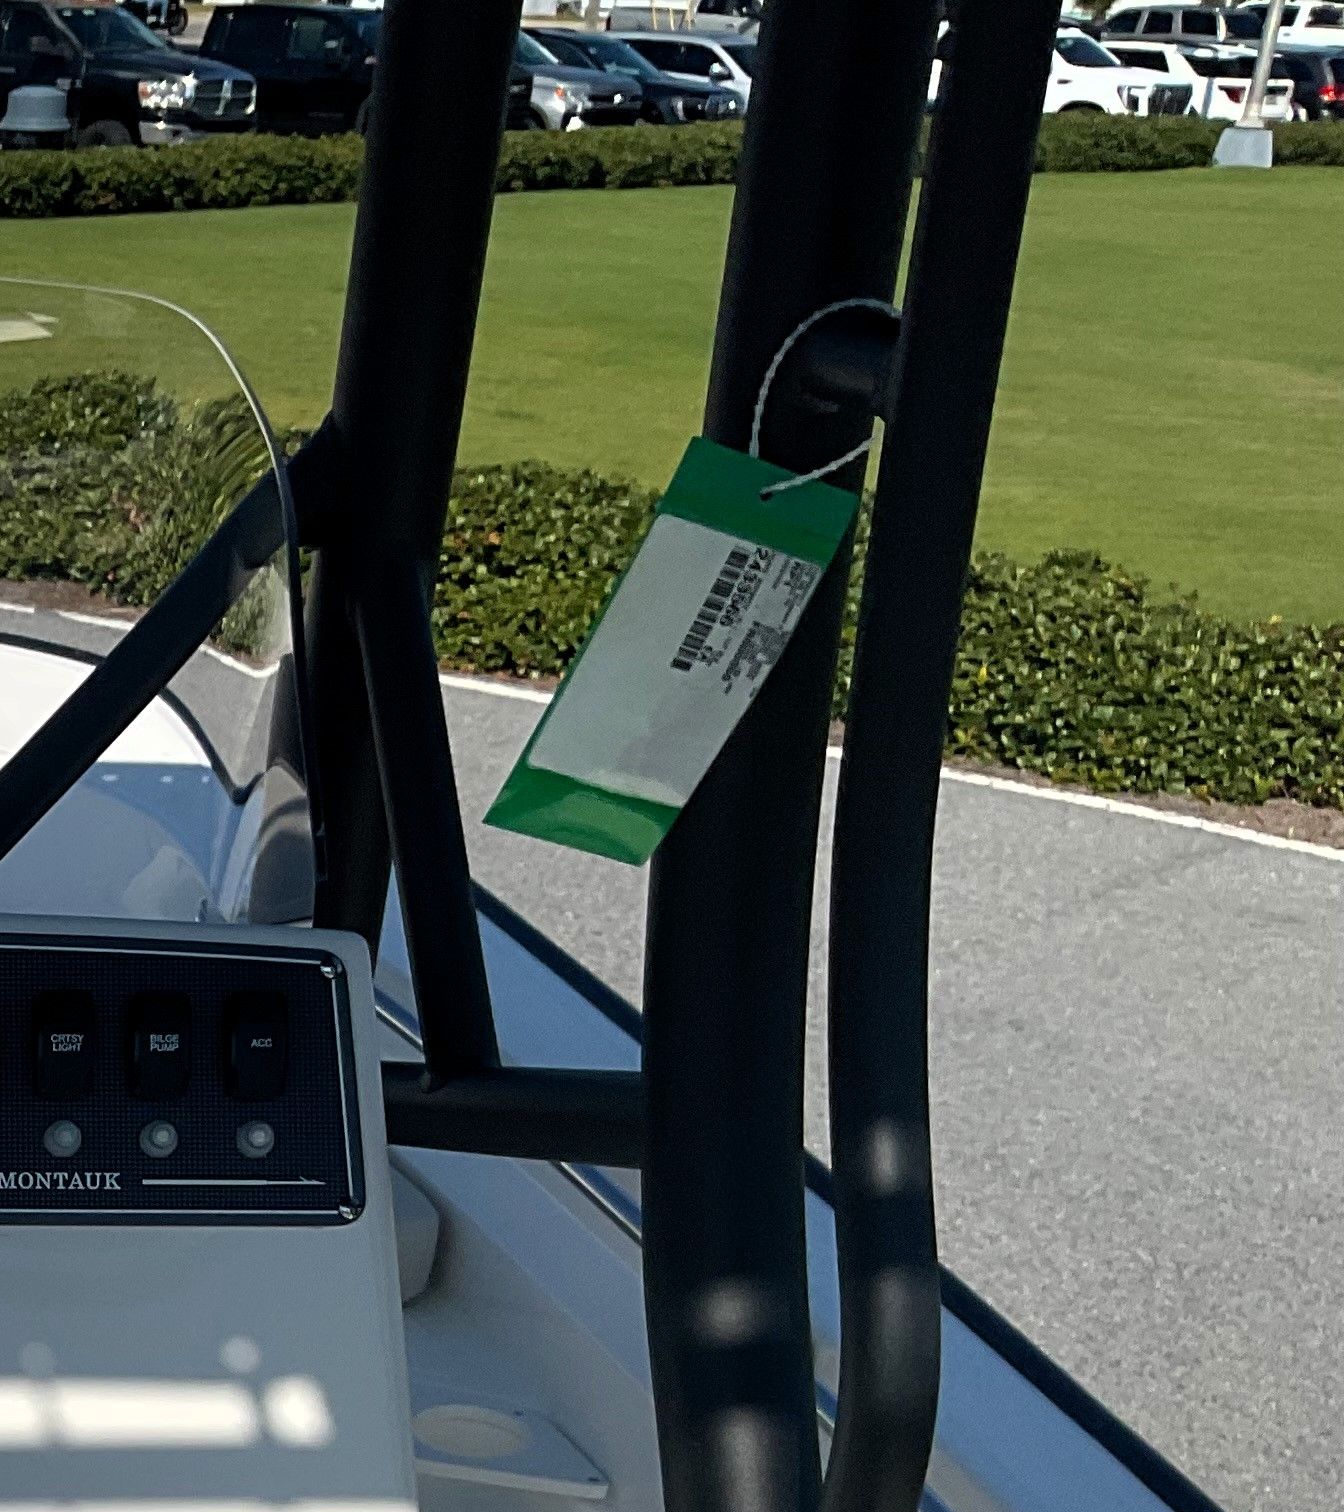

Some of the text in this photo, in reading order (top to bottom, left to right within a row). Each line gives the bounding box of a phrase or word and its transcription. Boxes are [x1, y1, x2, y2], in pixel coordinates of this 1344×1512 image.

[51, 1034, 84, 1043] CRTSY
[150, 1034, 179, 1043] BILGE
[251, 1038, 272, 1048] ACC
[52, 1042, 82, 1052] LIGHT
[150, 1042, 179, 1052] PUMP
